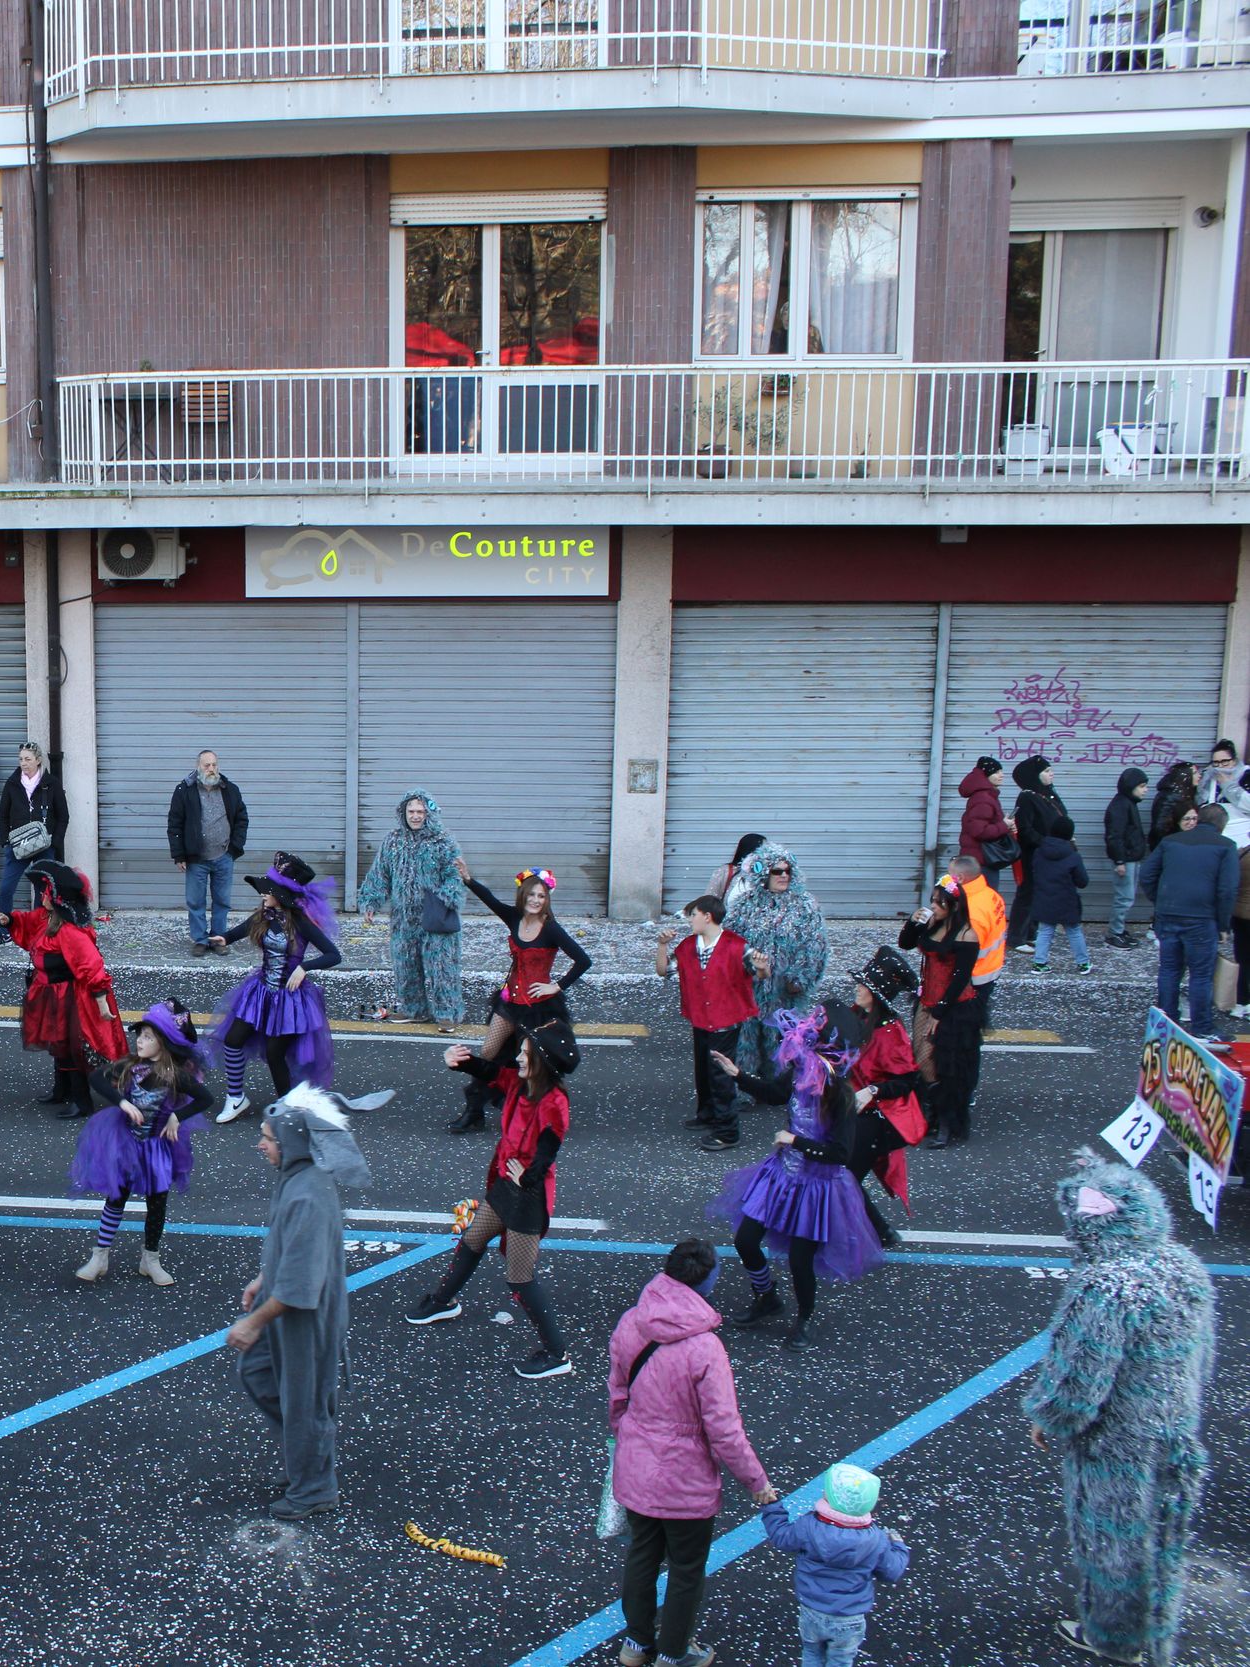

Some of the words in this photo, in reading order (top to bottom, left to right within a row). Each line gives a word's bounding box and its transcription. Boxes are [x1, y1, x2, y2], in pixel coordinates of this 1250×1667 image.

[525, 567, 596, 585] CITY
[1122, 1114, 1152, 1151] 13
[1195, 1171, 1214, 1214] 13
